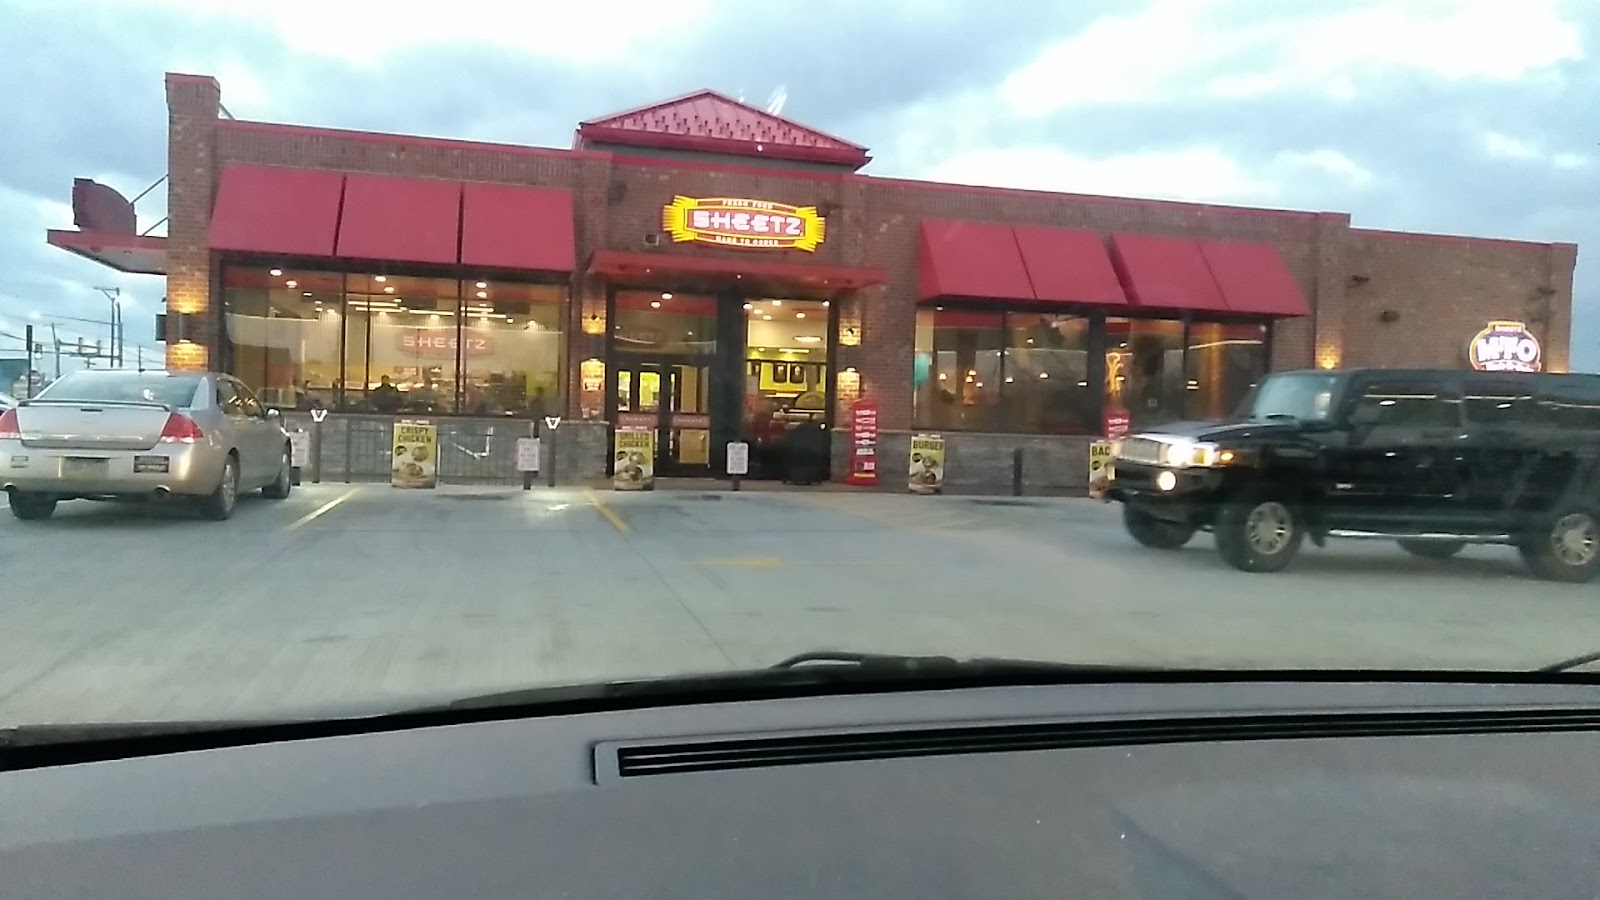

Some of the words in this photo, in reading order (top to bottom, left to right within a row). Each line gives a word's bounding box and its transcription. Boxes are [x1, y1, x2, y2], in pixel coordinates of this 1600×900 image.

[693, 210, 802, 235] SHEETZ
[401, 426, 429, 435] CRISPY
[398, 434, 432, 443] CHICKEN
